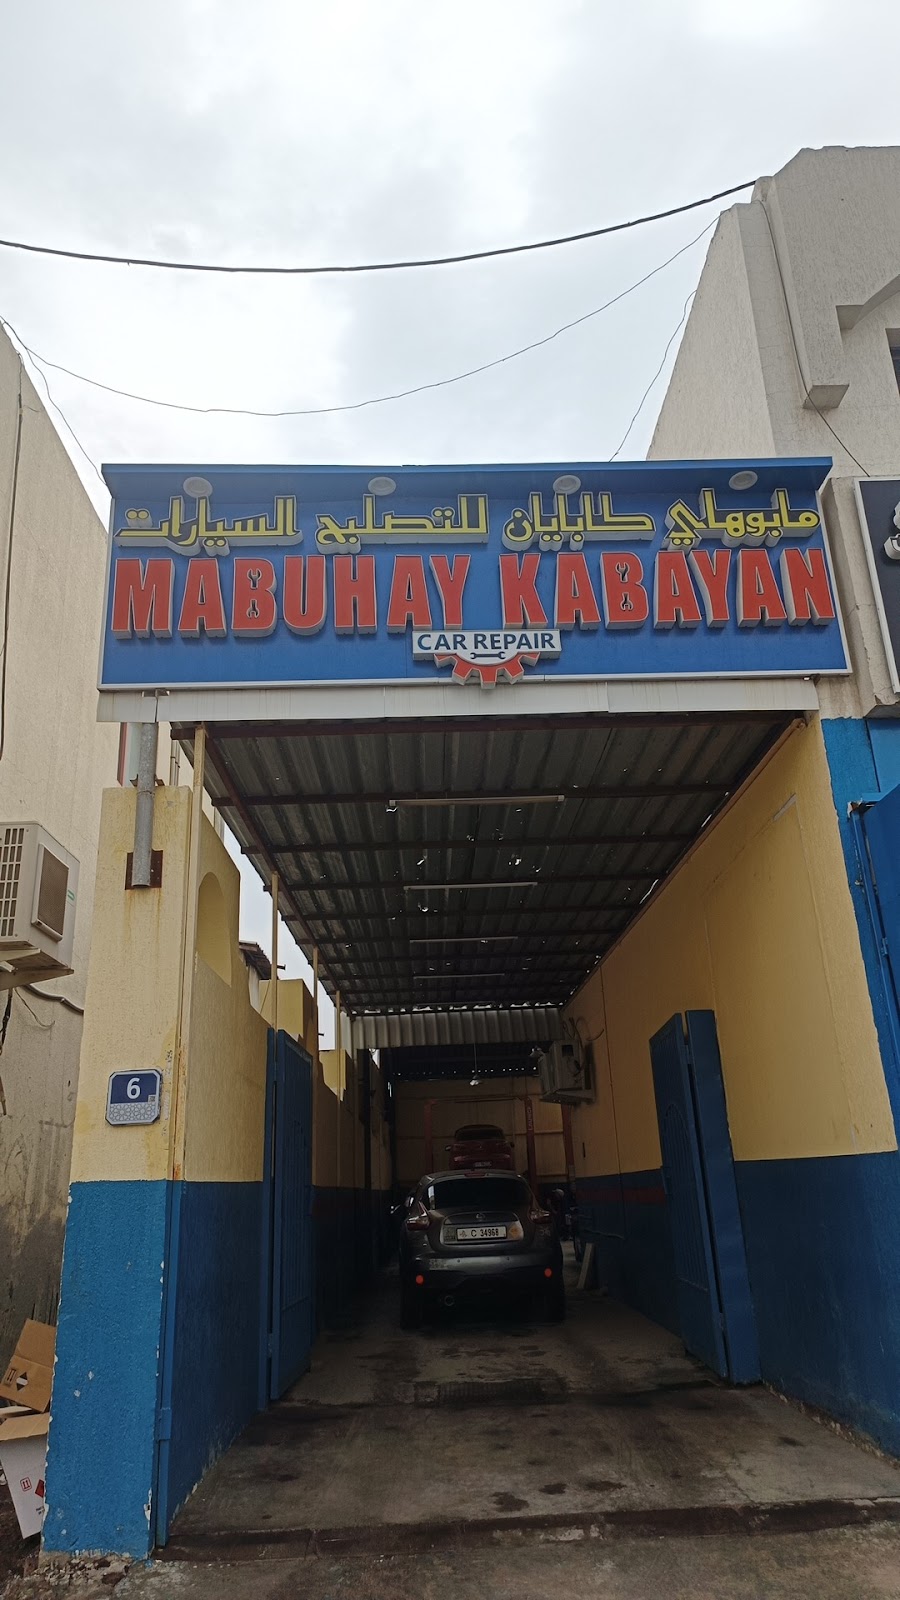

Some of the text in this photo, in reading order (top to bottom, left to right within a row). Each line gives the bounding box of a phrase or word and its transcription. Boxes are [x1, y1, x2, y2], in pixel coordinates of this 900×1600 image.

[115, 496, 299, 548] السيارات
[505, 493, 654, 543] كابايان
[111, 548, 836, 637] MABUHAY KABAYAN
[417, 633, 556, 650] CAR REPAIR
[126, 1077, 141, 1100] 6
[471, 1229, 477, 1237] C
